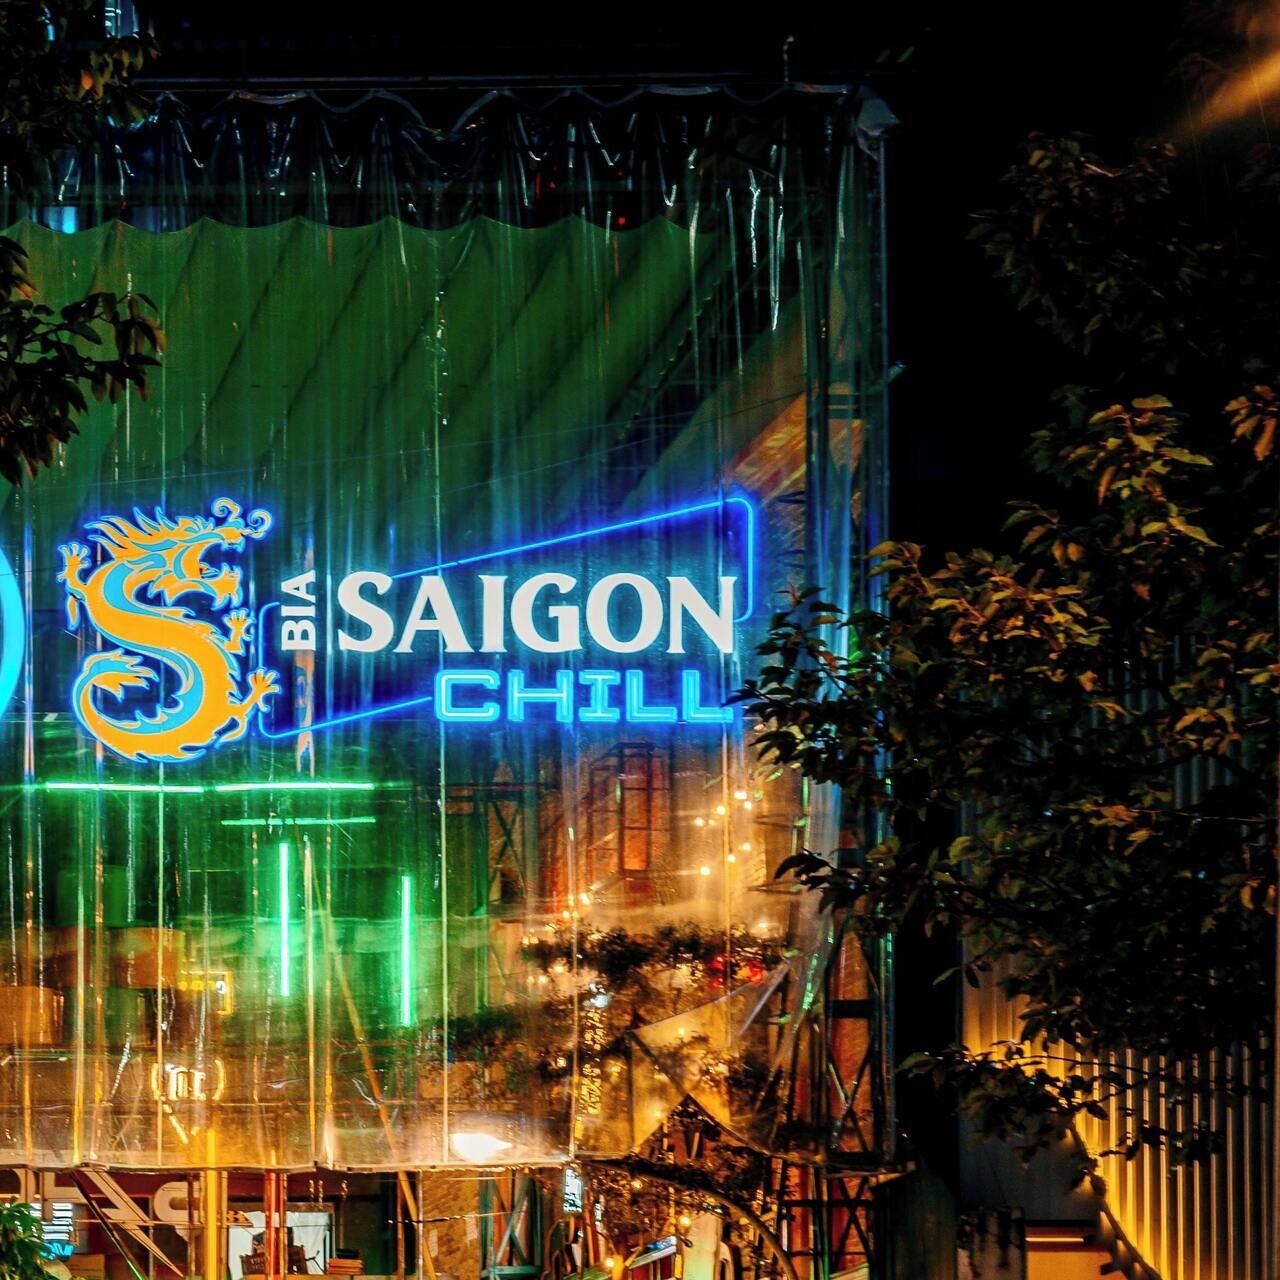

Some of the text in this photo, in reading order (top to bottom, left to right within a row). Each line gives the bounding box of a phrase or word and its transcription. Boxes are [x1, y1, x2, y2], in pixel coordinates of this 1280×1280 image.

[279, 569, 317, 652] BIA
[337, 571, 737, 655] SAIGON
[433, 668, 736, 724] CHILL
